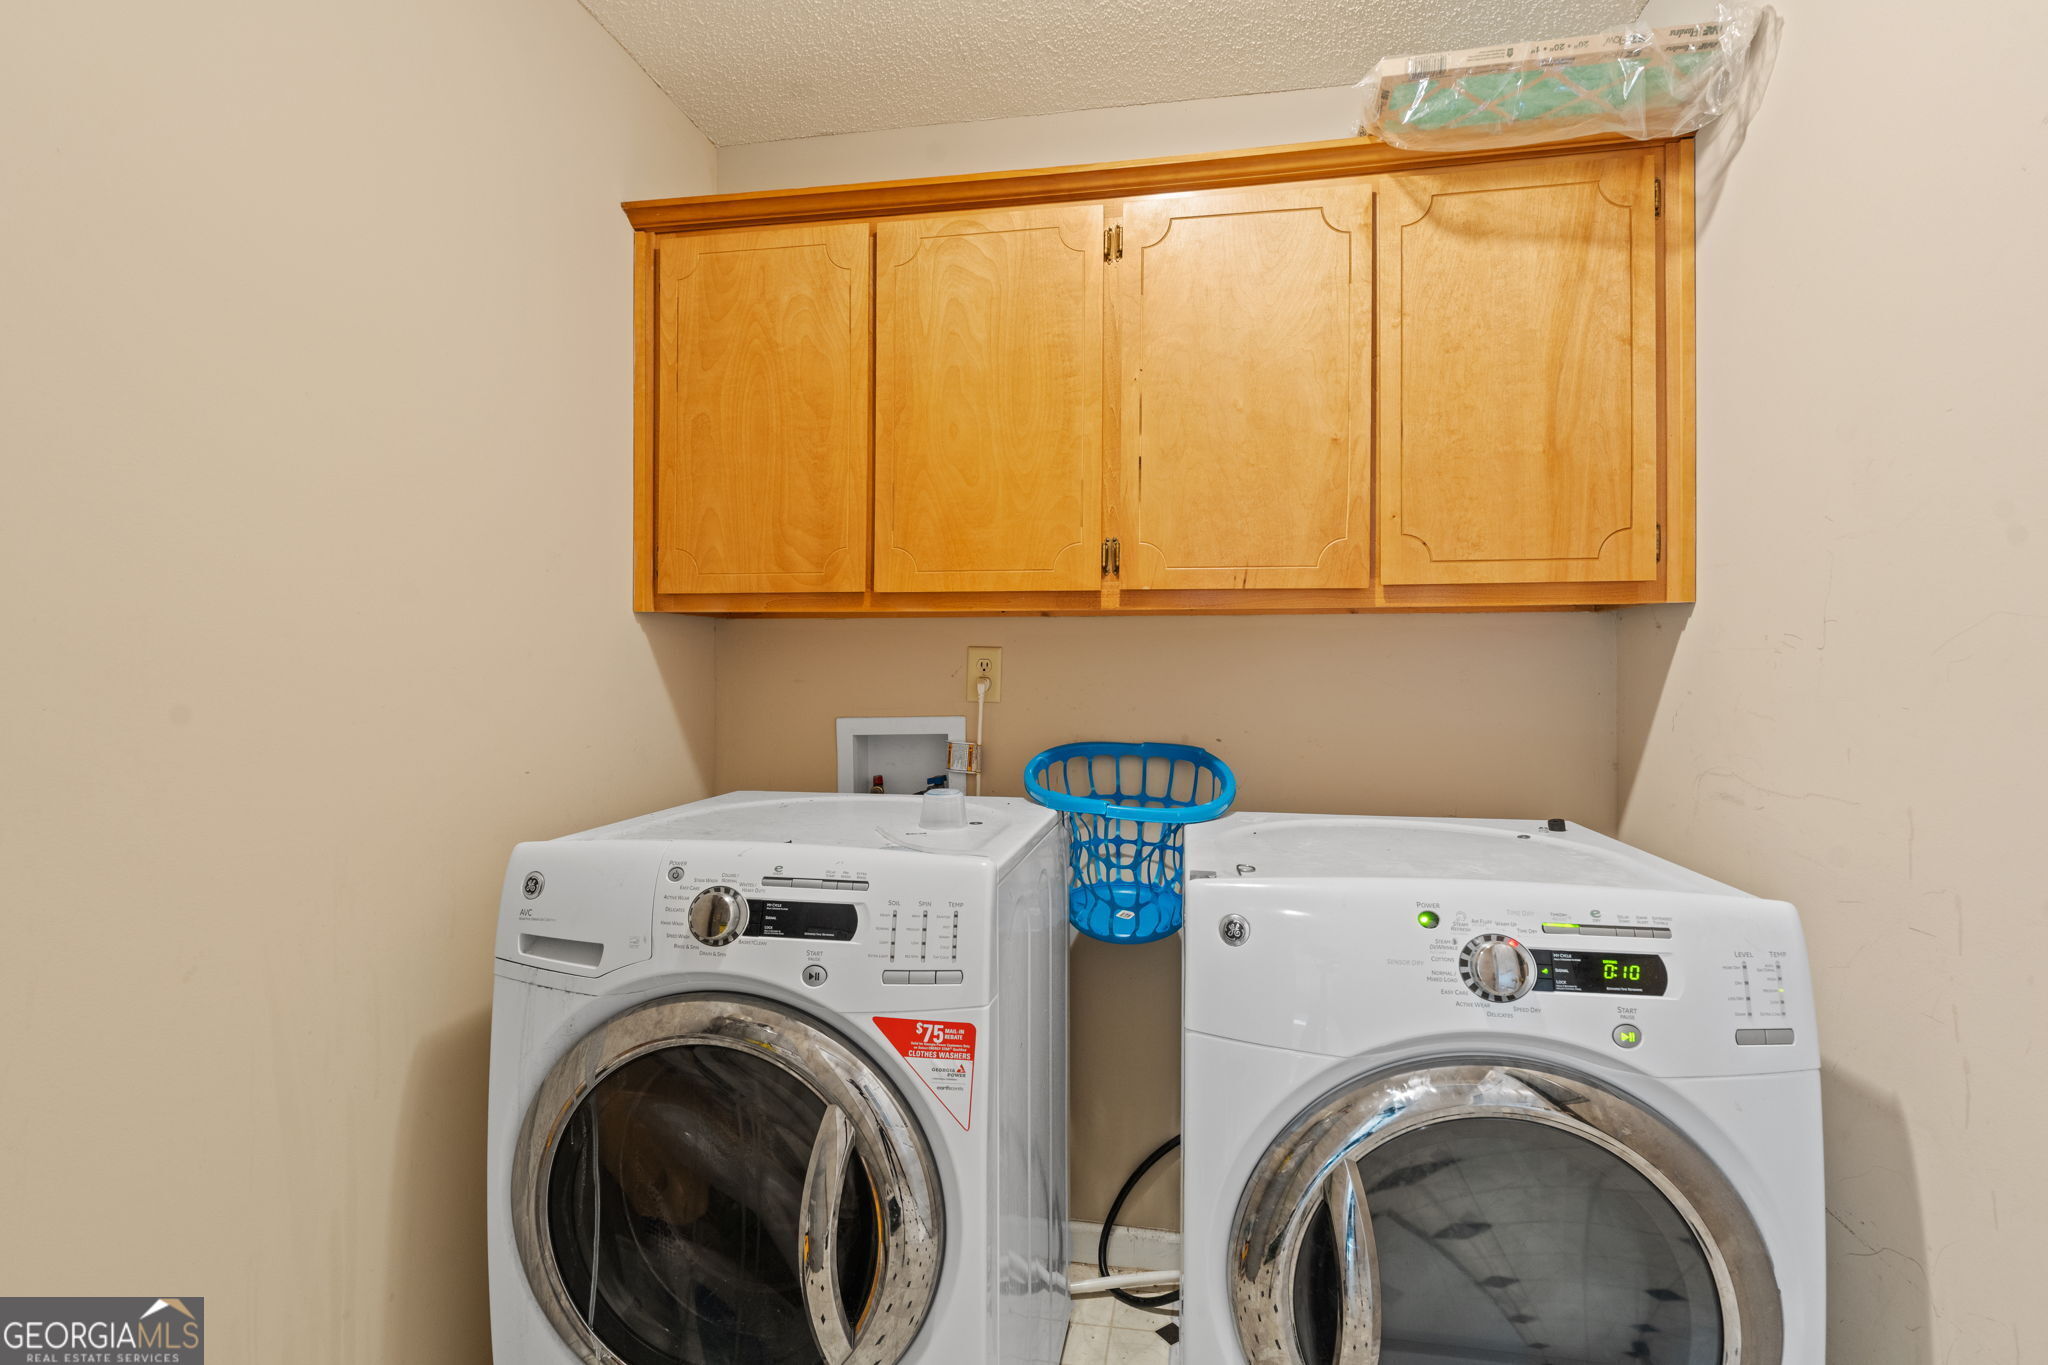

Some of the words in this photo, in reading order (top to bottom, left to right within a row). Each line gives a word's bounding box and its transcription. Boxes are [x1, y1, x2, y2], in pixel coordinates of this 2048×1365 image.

[1416, 901, 1440, 909] POWER
[806, 949, 823, 957] START
[1603, 964, 1640, 980] 0:10
[1617, 1006, 1637, 1014] START
[916, 1022, 944, 1044] $75
[908, 1049, 937, 1058] CLOTHES
[938, 1051, 971, 1060] WASHERS
